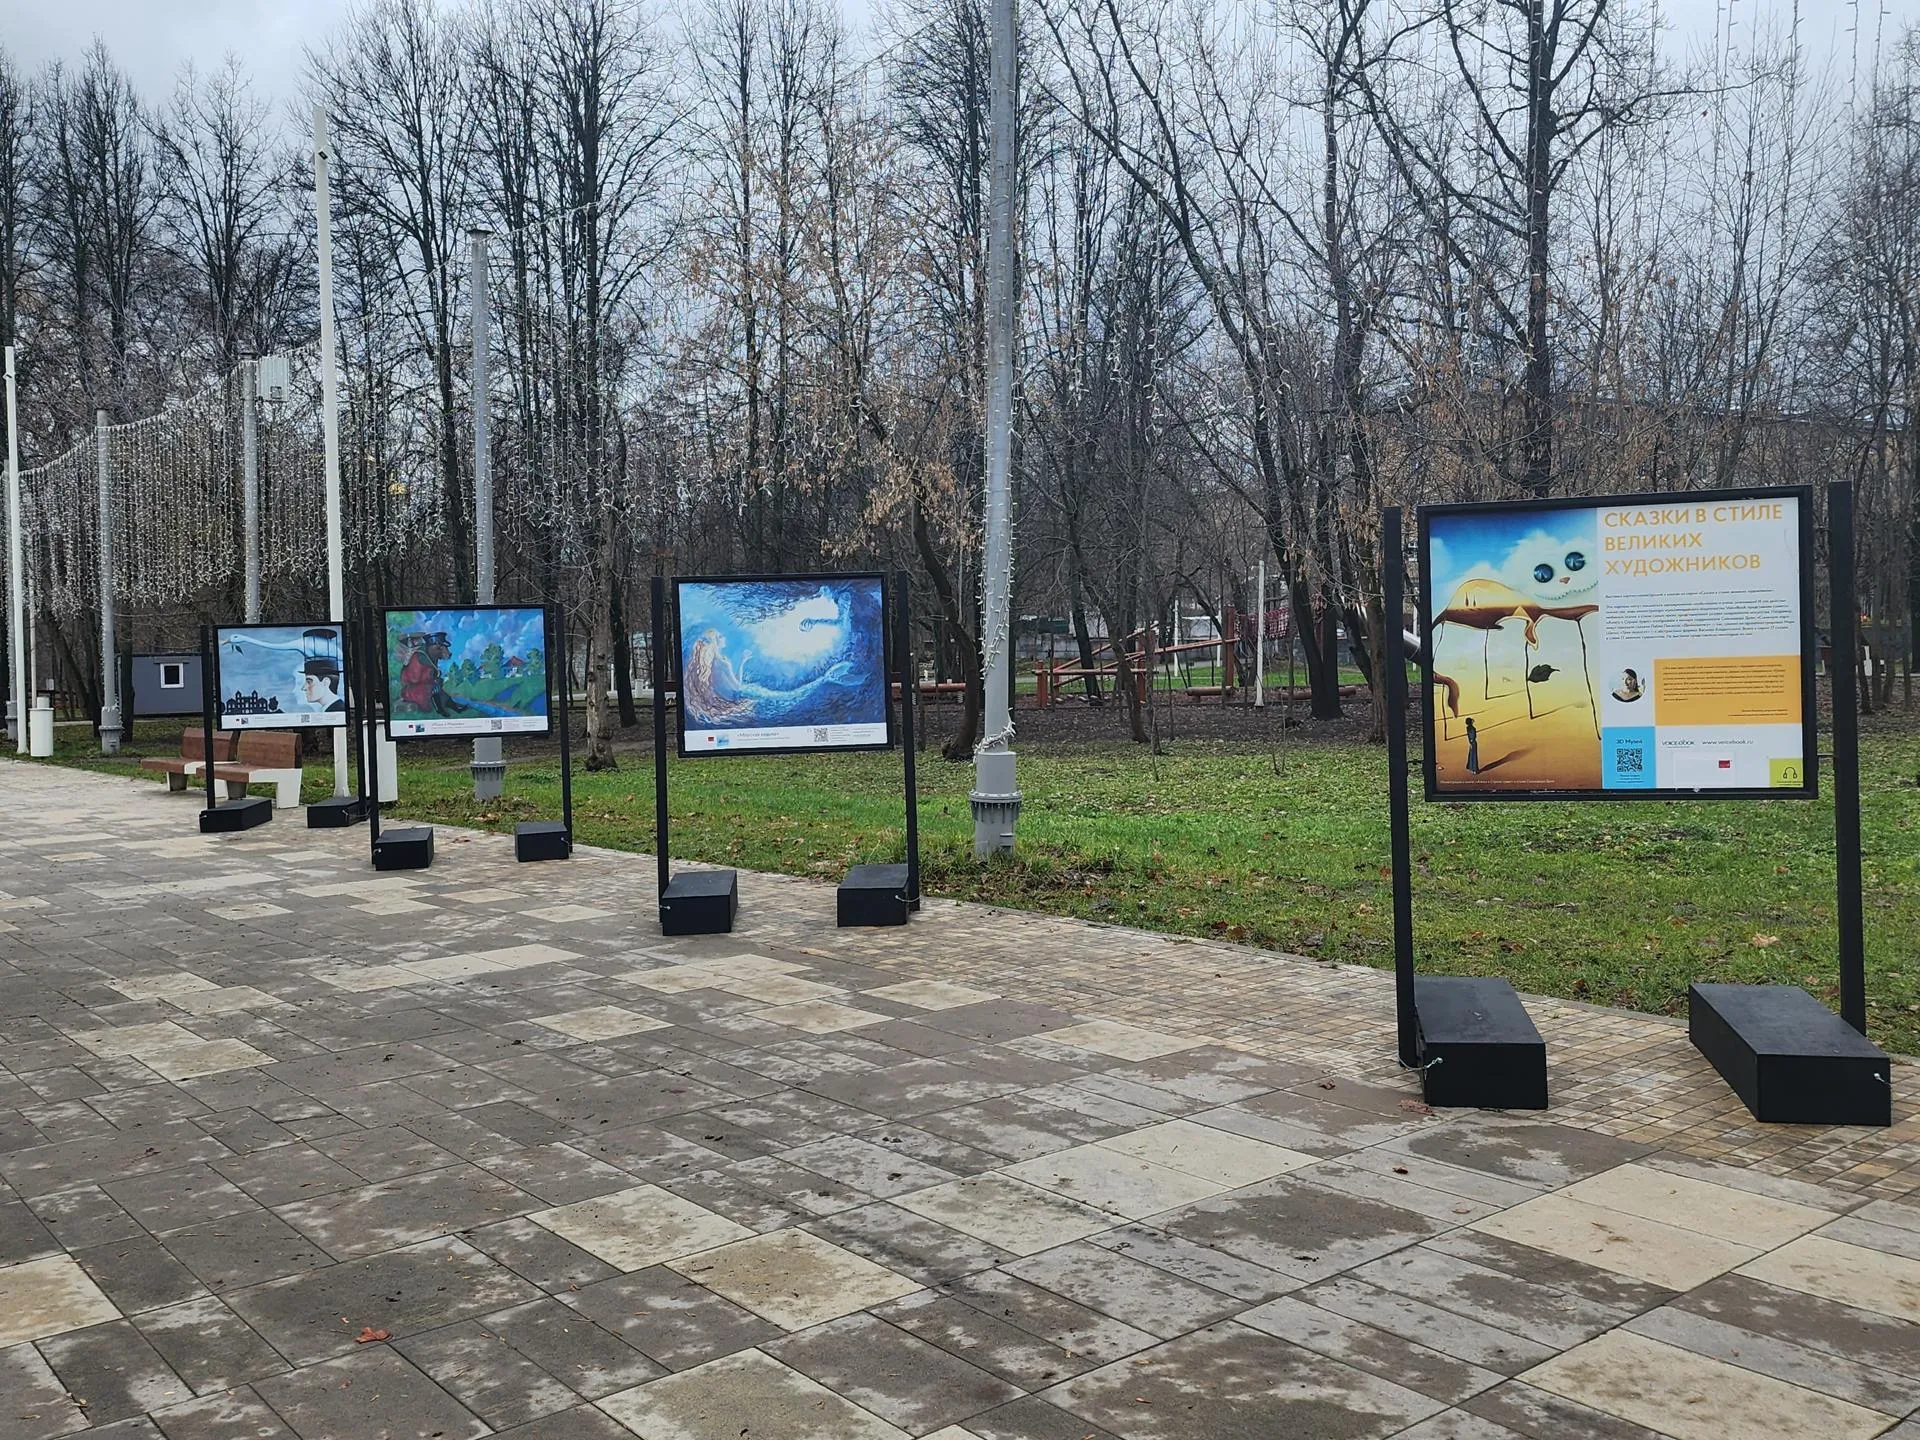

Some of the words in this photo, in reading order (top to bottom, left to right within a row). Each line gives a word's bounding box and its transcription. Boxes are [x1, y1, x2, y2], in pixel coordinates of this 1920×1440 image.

[1604, 508, 1689, 528] СКАЗКИ
[1695, 507, 1707, 523] В
[1713, 504, 1783, 523] СТИЛЕ
[1605, 532, 1702, 551] ВЕЛИКИХ
[1605, 554, 1761, 577] ХУДОЖНИКОВ
